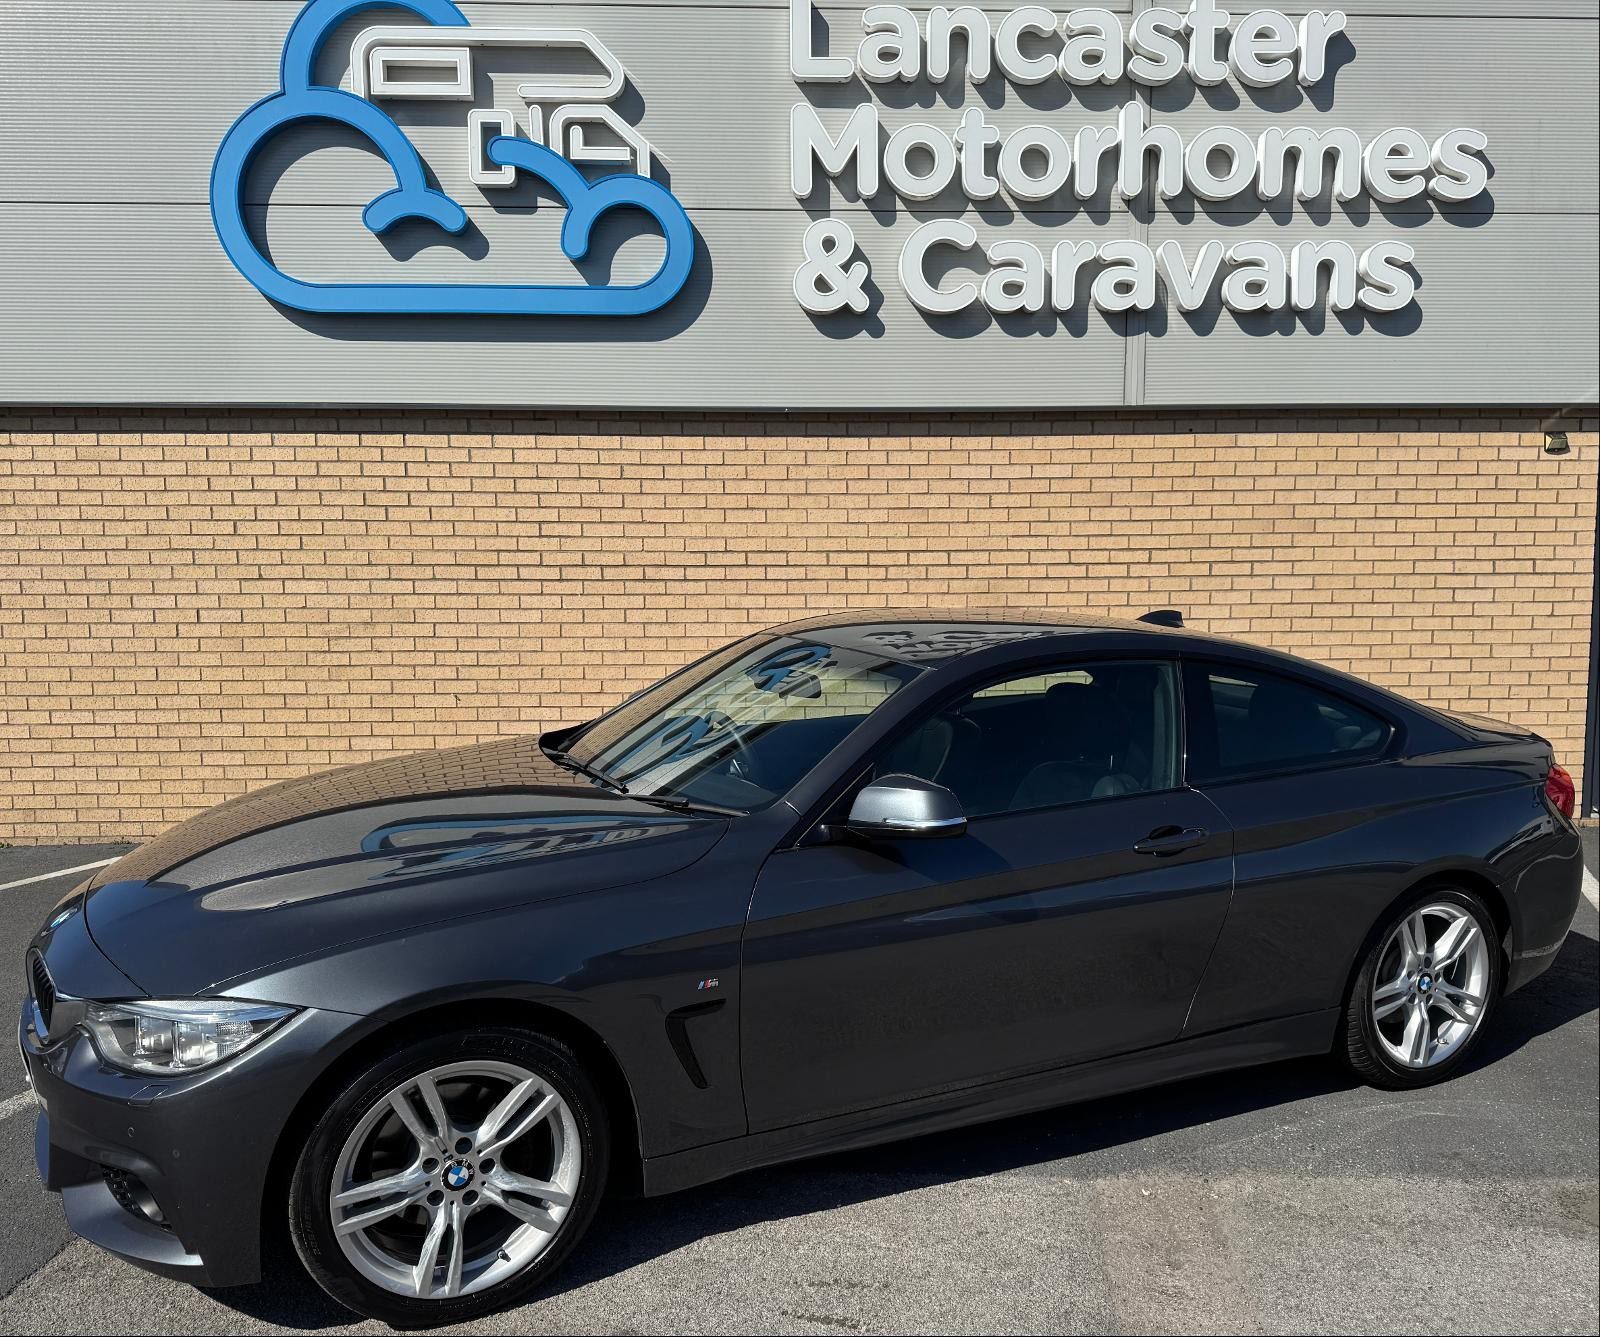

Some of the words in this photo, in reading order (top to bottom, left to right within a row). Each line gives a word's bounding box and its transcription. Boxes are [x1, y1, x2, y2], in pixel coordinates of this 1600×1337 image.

[790, 0, 1347, 87] Lancaster
[791, 101, 1488, 202] Motorhomes
[792, 218, 870, 313] &
[898, 218, 1416, 313] Caravans
